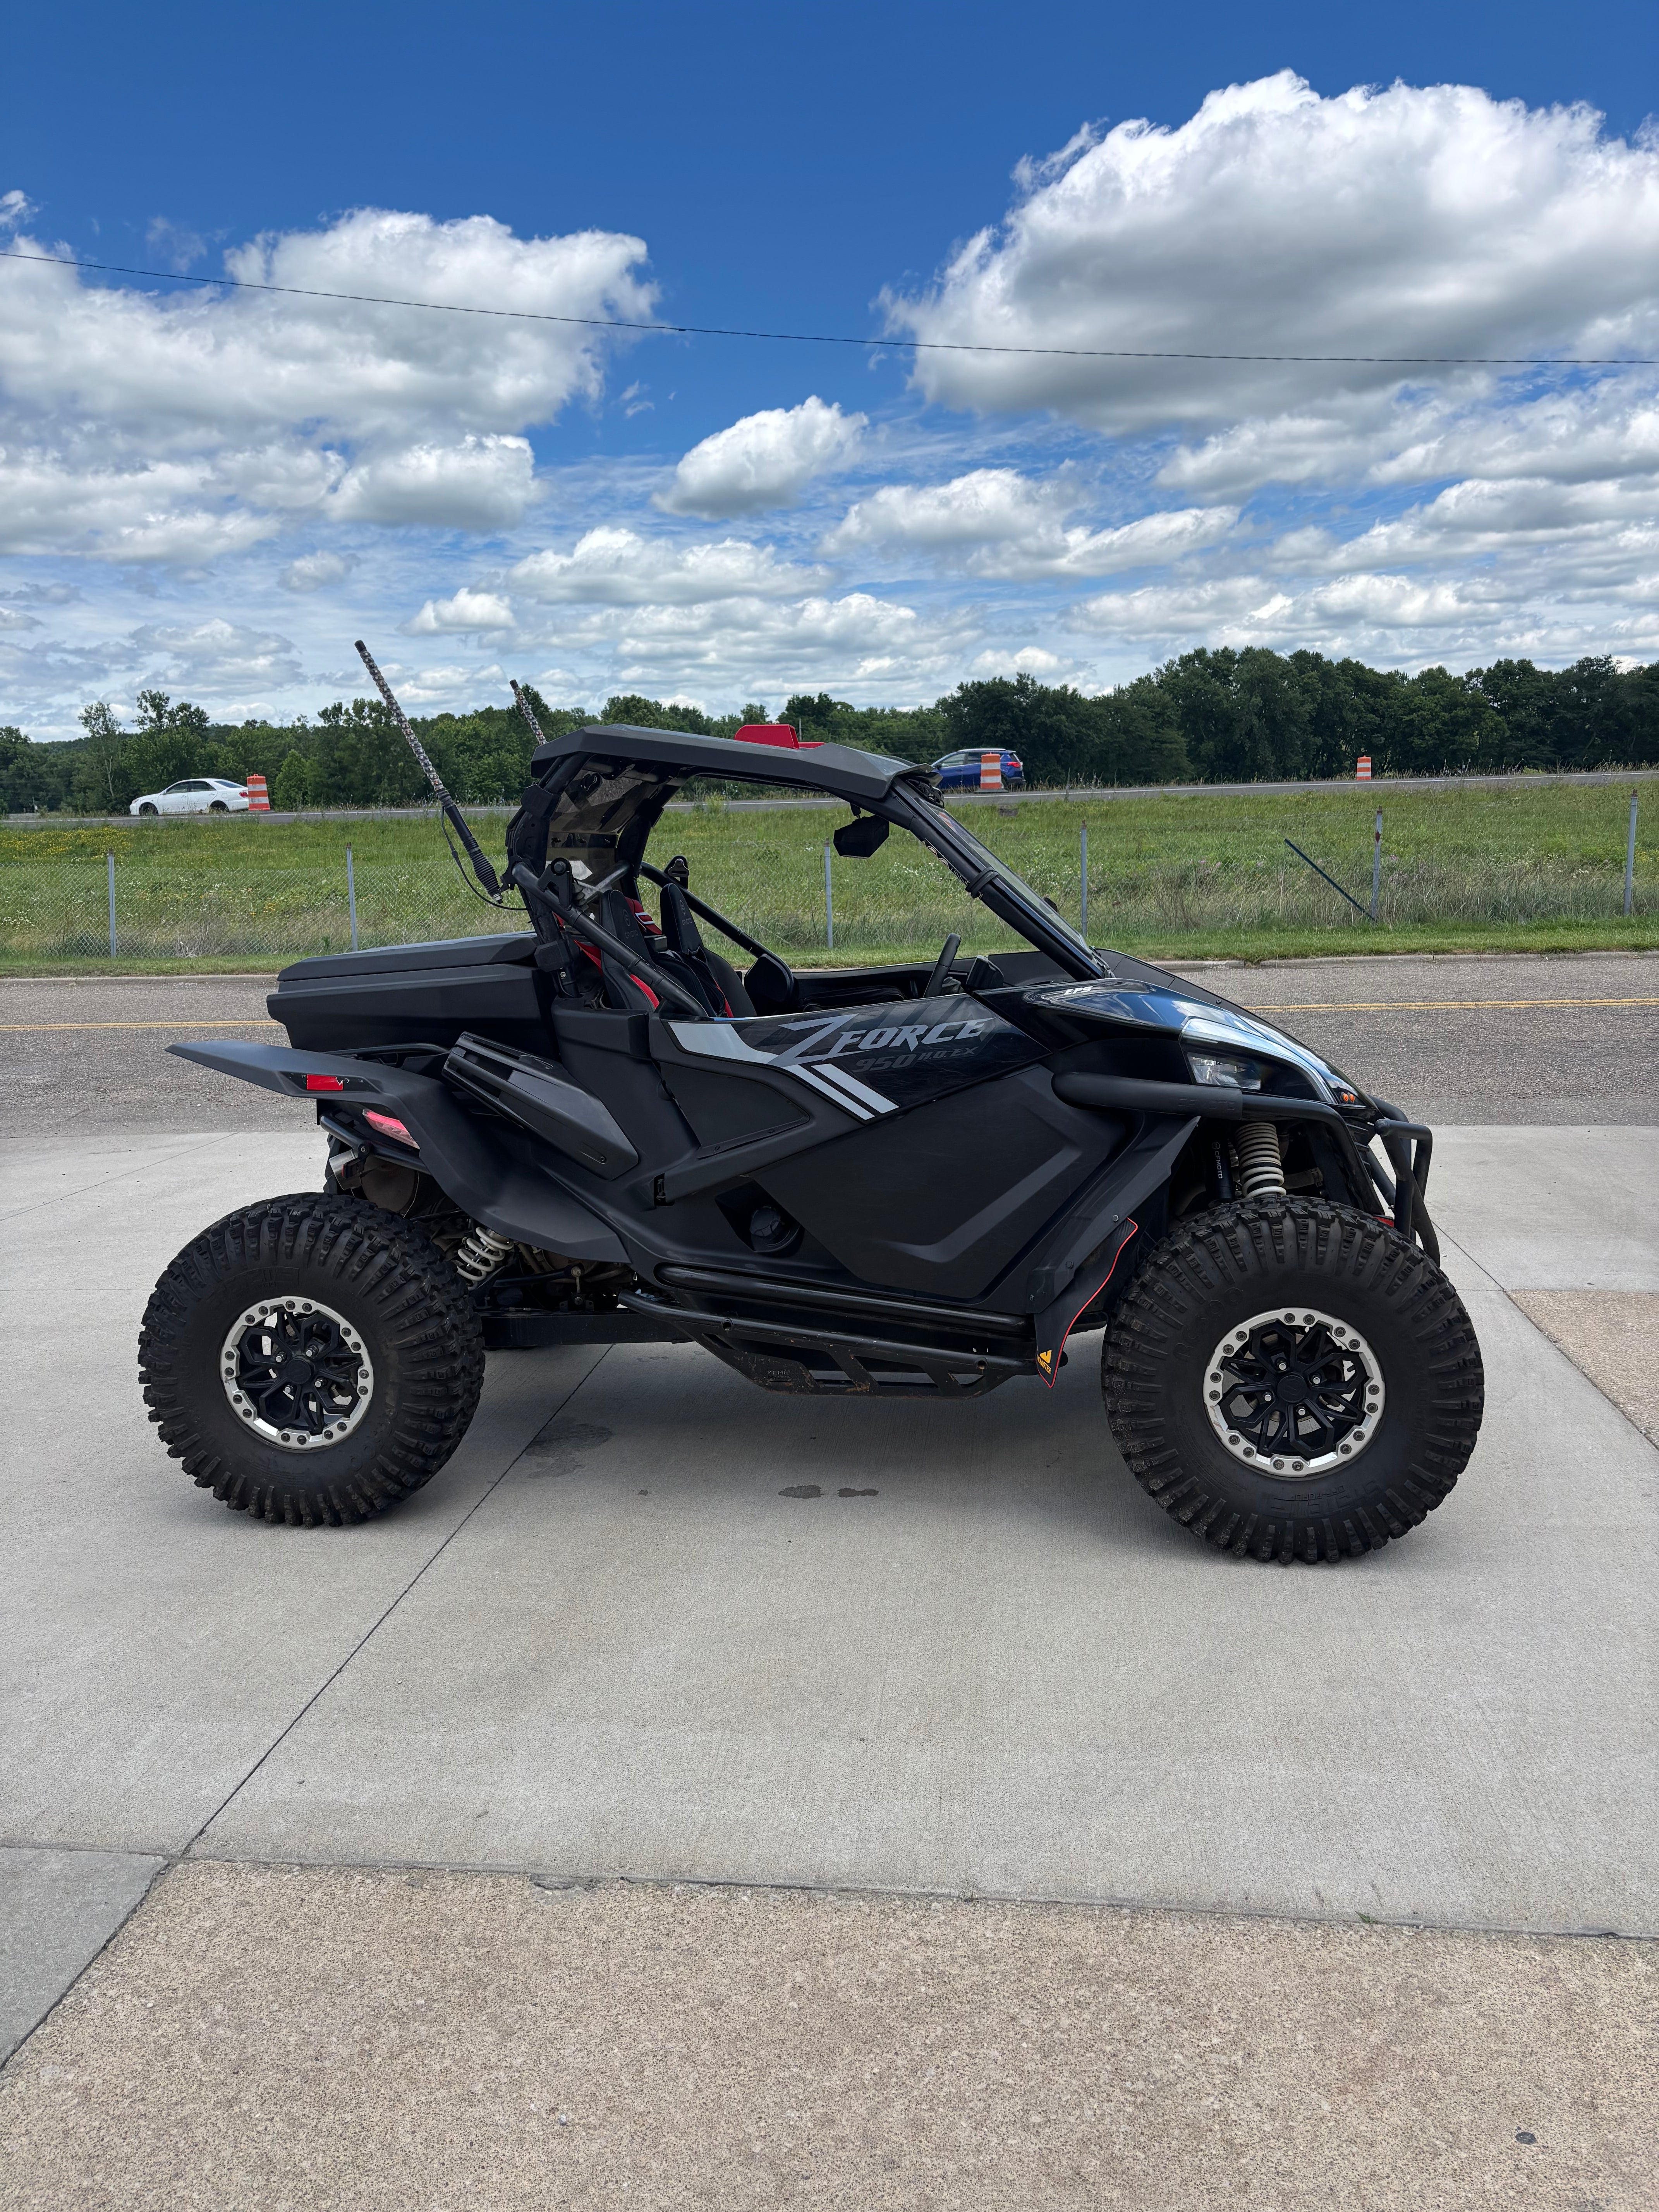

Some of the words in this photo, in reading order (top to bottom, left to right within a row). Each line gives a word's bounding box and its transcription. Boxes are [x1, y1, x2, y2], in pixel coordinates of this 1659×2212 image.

[1064, 985, 1093, 995] EPS
[852, 1053, 917, 1073] 950
[950, 1047, 978, 1058] EX
